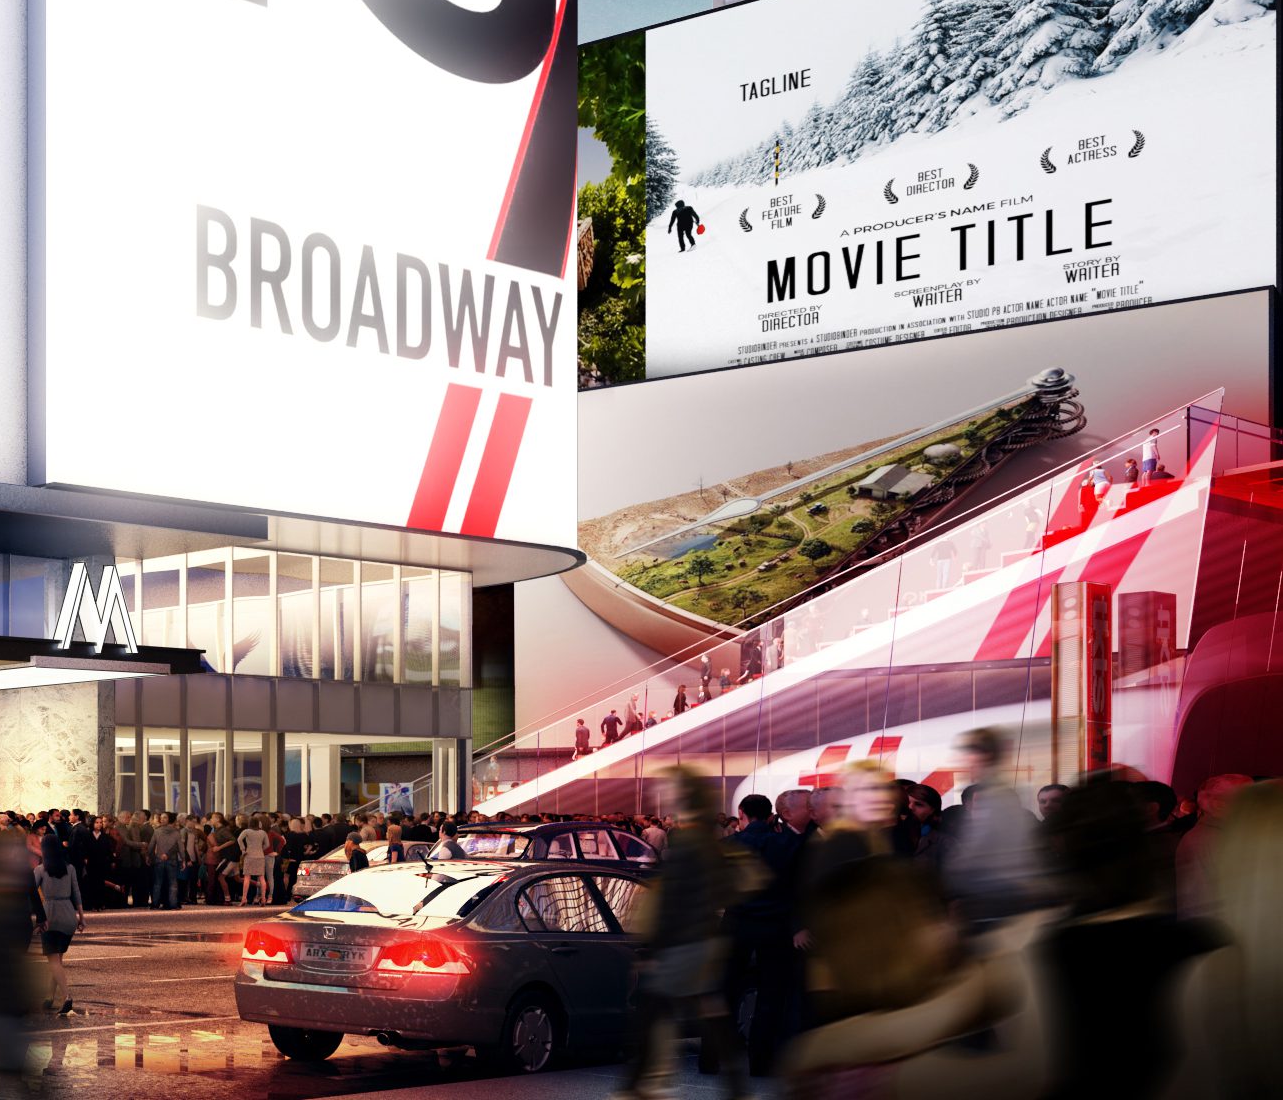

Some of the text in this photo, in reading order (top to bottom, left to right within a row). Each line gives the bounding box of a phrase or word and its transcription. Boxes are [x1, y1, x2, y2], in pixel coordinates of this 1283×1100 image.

[739, 68, 811, 102] TAGLINE
[1078, 135, 1106, 150] BEST
[1067, 145, 1118, 165] ACTRESS
[917, 167, 944, 182] BEST
[906, 177, 955, 196] DIRECTOR
[770, 194, 794, 208] BEST
[762, 204, 802, 220] FEATURE
[839, 194, 1034, 237] A PRODUCER'S NAME FILM
[771, 217, 793, 230] FILM
[767, 198, 1113, 304] MOVIE TITLE
[1063, 254, 1121, 270] STORY BY
[1065, 262, 1120, 284] WRITER
[196, 203, 563, 388] BROADWAY
[894, 278, 981, 298] SCREENPLAY BY
[913, 288, 962, 308] WRITER
[758, 304, 823, 320] DIRECTED BY
[762, 311, 819, 332] DIRECTOR
[779, 338, 808, 349] PRESENTS
[816, 328, 858, 343] STUDIOBINDER
[860, 324, 896, 336] PRODUCTION
[907, 317, 946, 328] ASSOCIATION
[949, 314, 965, 322] WITH
[967, 308, 989, 320] STUDIO
[1003, 302, 1023, 314] ACTOR
[1026, 299, 1044, 310] NAME
[1046, 295, 1068, 308] ACTOR
[1071, 292, 1088, 303] NAME
[1091, 287, 1117, 300] "MOVIE
[1120, 280, 1144, 297] TITLE"
[53, 562, 139, 654] M
